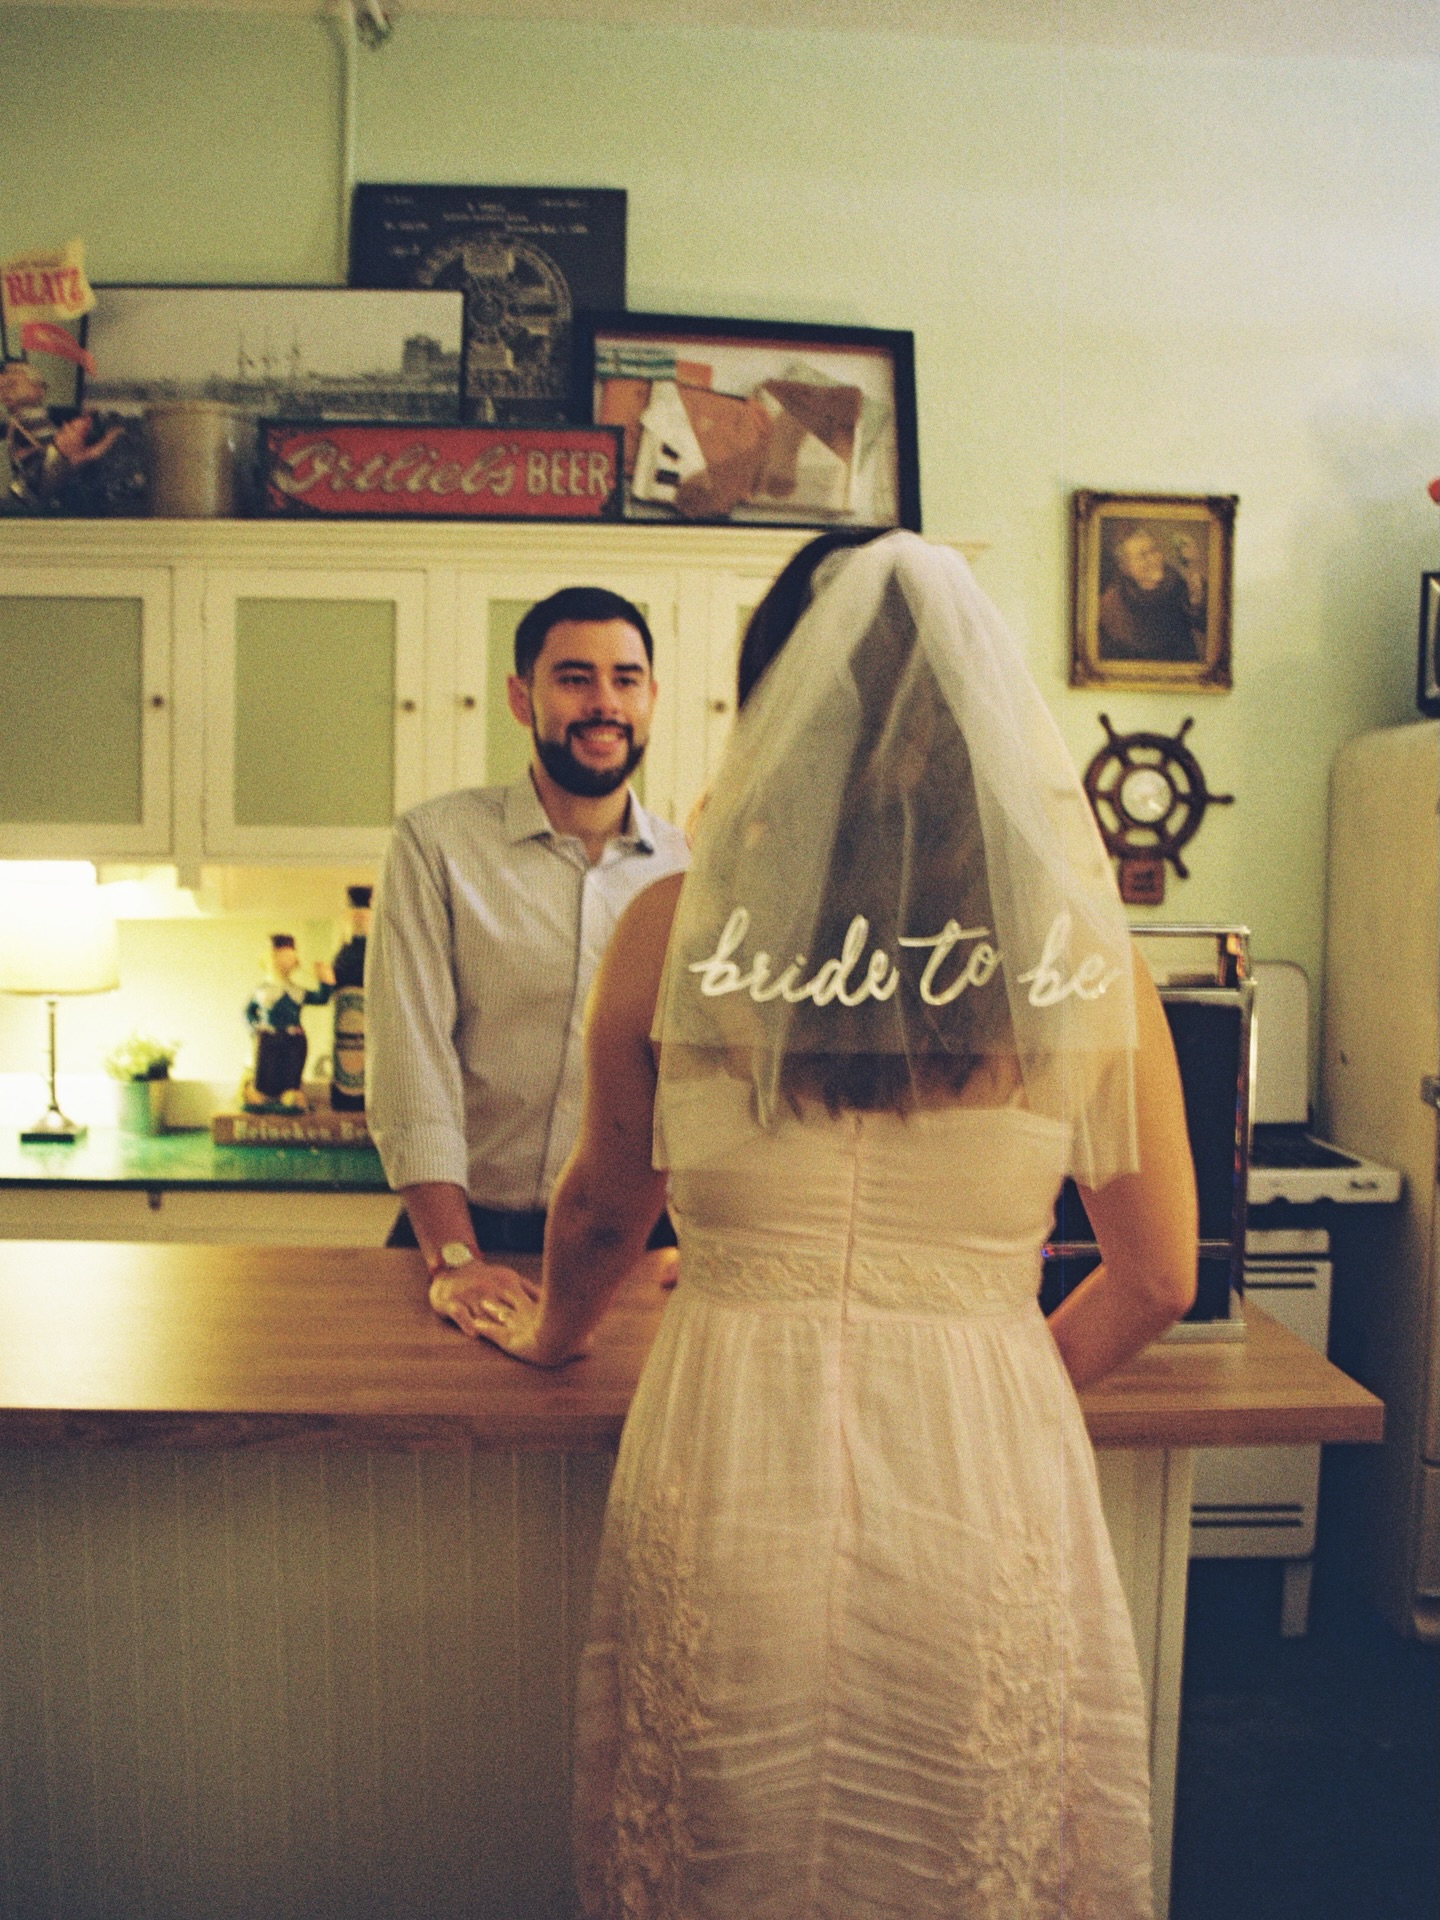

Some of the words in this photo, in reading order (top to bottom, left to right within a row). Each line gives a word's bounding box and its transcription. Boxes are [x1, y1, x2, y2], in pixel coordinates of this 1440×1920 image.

[6, 266, 85, 311] BLATZ
[526, 450, 609, 496] BEER
[688, 906, 899, 1007] bride
[898, 919, 1001, 1006] to
[1017, 907, 1118, 1007] be
[339, 1121, 368, 1142] Be
